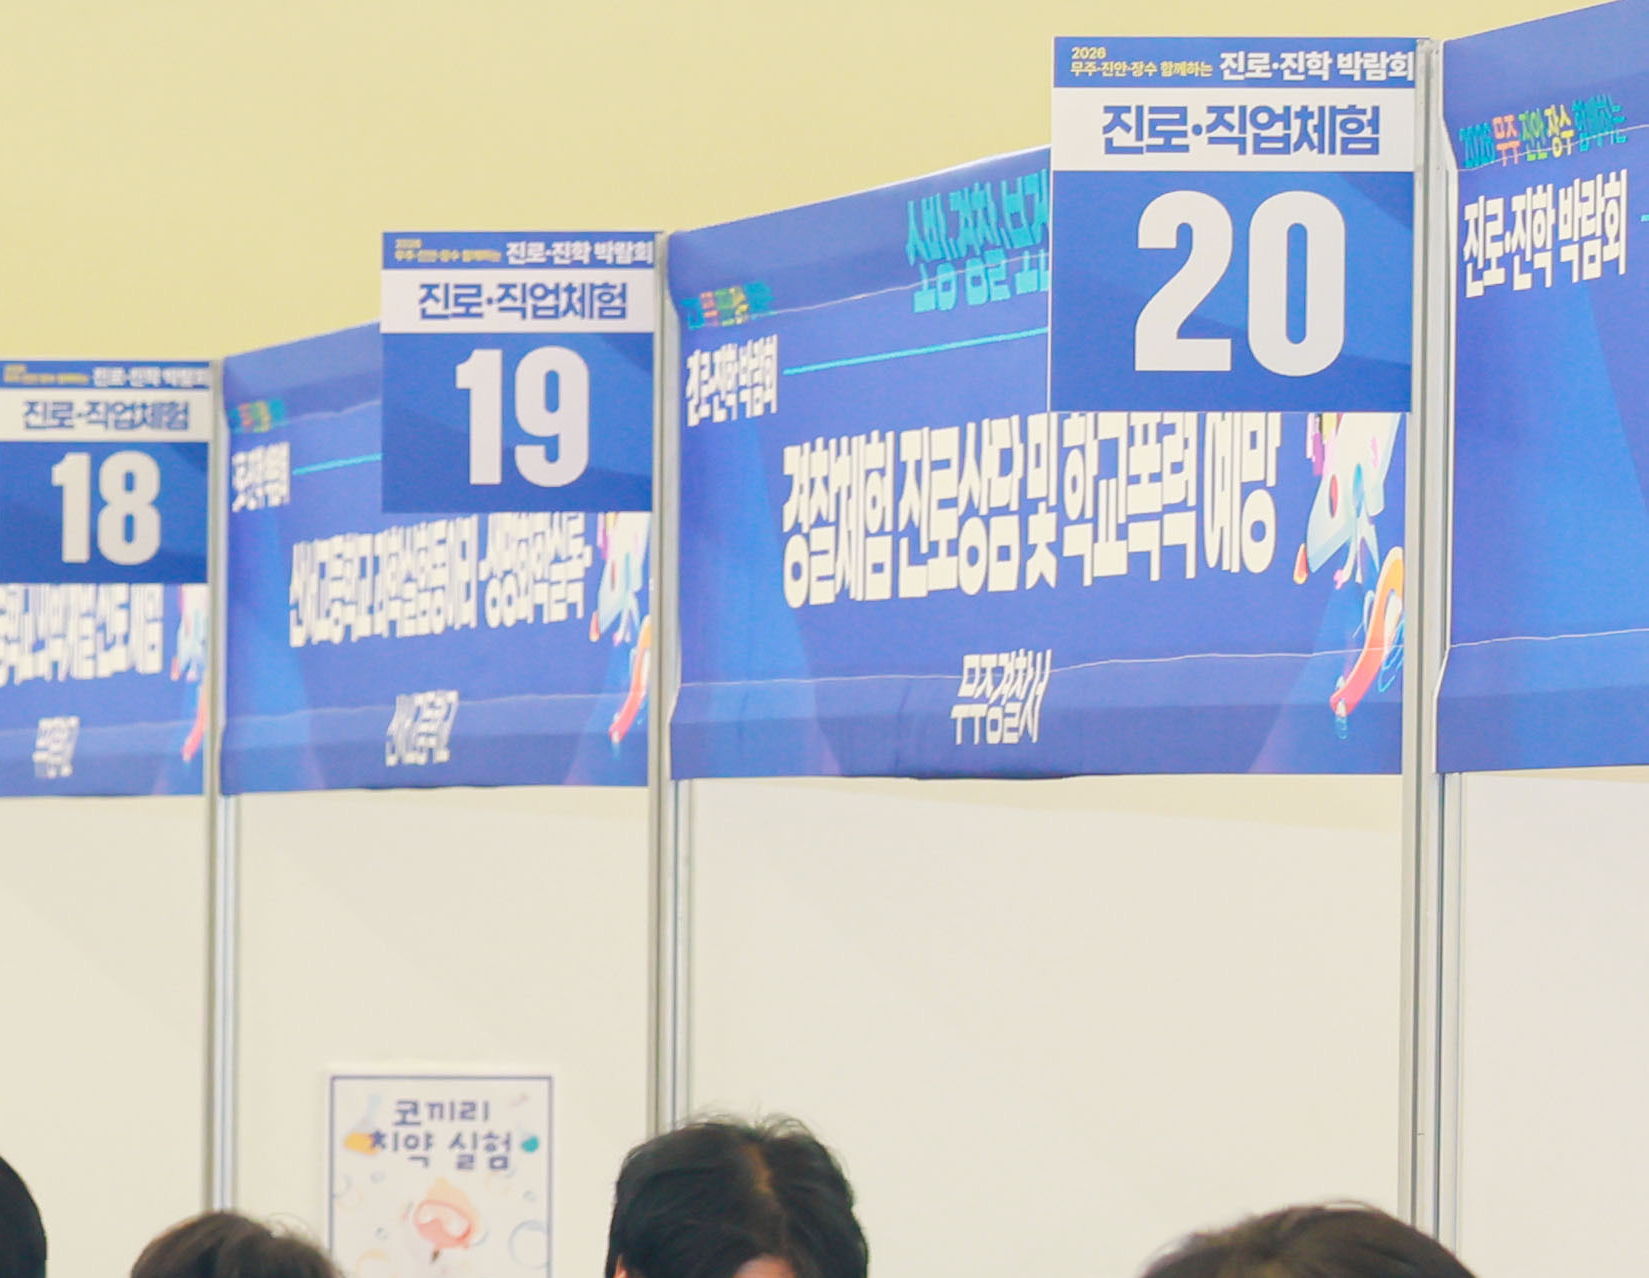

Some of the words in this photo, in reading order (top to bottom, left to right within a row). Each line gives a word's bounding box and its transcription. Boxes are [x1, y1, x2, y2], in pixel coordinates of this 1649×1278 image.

[1160, 60, 1213, 77] 함께하는
[1219, 51, 1332, 81] 진로·진학
[1337, 51, 1415, 82] 박람회
[1101, 104, 1381, 156] 진로·직업체험
[1463, 183, 1557, 298] 진로·진학
[1558, 168, 1628, 284] 박람회
[419, 283, 627, 321] 진로·직업체험
[1134, 190, 1346, 377] 20
[22, 399, 189, 431] 진로·직업체험
[455, 346, 591, 487] 19
[51, 450, 162, 565] 18
[782, 429, 896, 608] 경찰체험
[897, 415, 1024, 600] 진로상담
[1026, 412, 1057, 590] 및
[1061, 411, 1197, 587] 학교폭력
[1204, 411, 1282, 575] 예방
[392, 1099, 492, 1128] 코끼리
[369, 1129, 436, 1169] 치약
[448, 1130, 513, 1171] 실험
